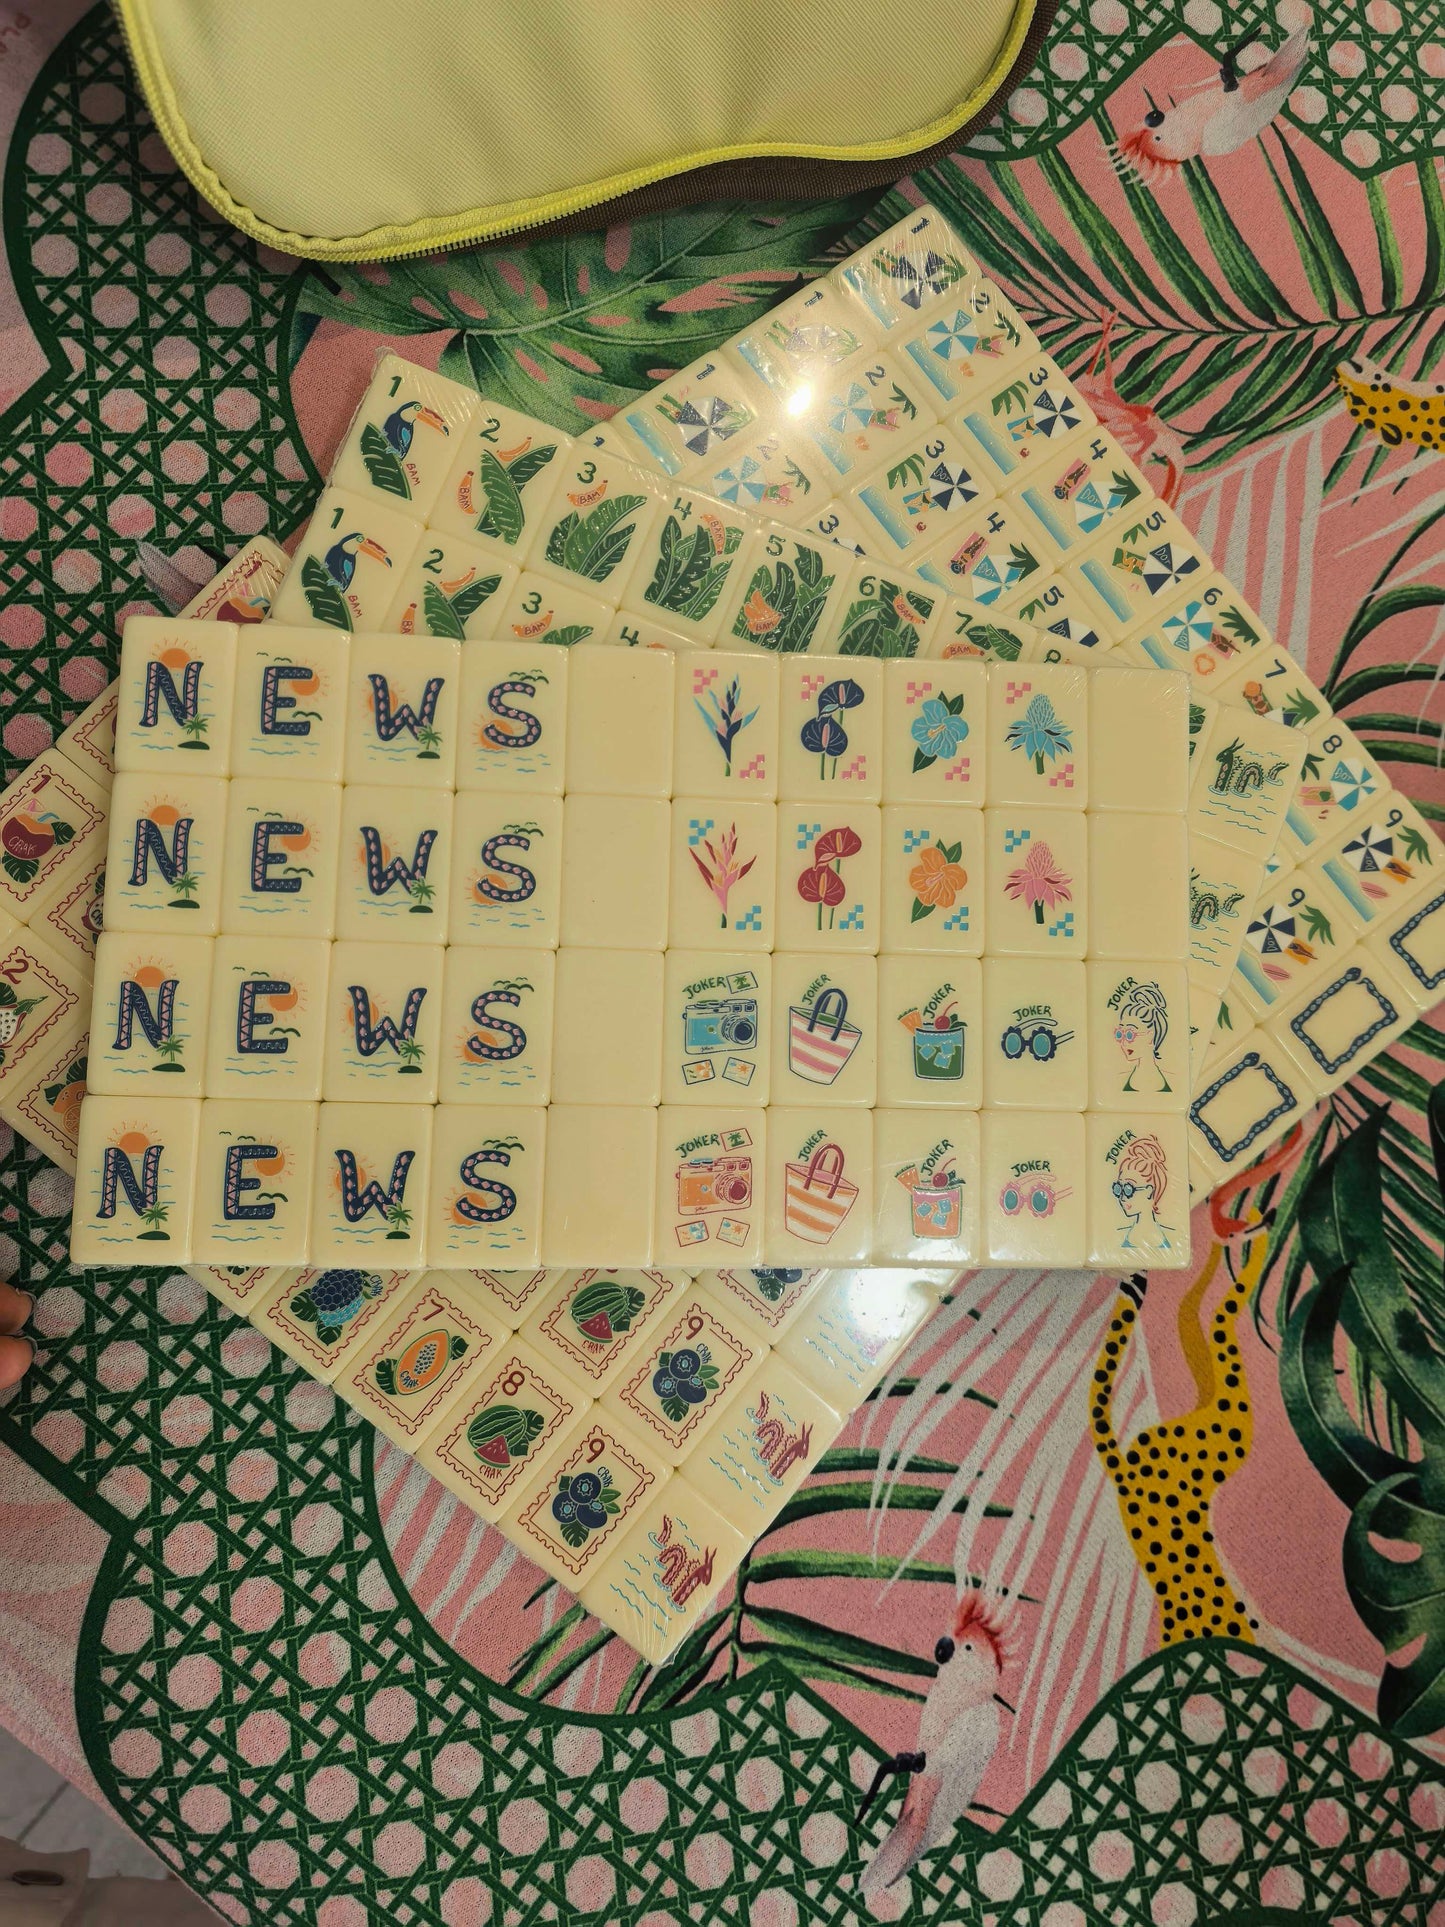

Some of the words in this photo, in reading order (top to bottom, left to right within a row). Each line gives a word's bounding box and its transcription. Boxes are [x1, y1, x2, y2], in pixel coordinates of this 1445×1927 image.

[910, 216, 930, 235] 1
[804, 290, 824, 308] 1
[969, 292, 990, 313] 2
[696, 363, 716, 381] 1
[865, 365, 886, 387] 2
[1029, 367, 1048, 387] 3
[387, 375, 403, 397] 1
[479, 418, 501, 443] 2
[925, 440, 945, 459] 3
[1090, 439, 1107, 460] 4
[406, 463, 421, 487] BAM
[577, 462, 597, 484] 3
[459, 487, 472, 510] BAM
[578, 489, 601, 505] BAM
[330, 507, 345, 530] 1
[673, 497, 692, 521] 4
[711, 520, 724, 543] BAM
[819, 514, 839, 534] 3
[987, 511, 1006, 533] 4
[1146, 511, 1166, 531] 5
[766, 535, 786, 557] 5
[423, 549, 444, 574] 2
[859, 576, 877, 597] 6
[1043, 585, 1064, 607] 5
[1204, 587, 1223, 606] 6
[348, 595, 362, 619] BAM
[522, 591, 543, 614] 3
[896, 602, 914, 622] BAM
[523, 620, 546, 635] BAM
[755, 619, 775, 633] BAM
[955, 610, 973, 635] 7
[620, 626, 640, 646] 4
[950, 645, 972, 655] BAM
[1265, 658, 1287, 679] 7
[138, 661, 204, 728] N
[261, 665, 314, 736] E
[367, 673, 446, 743] W
[484, 680, 543, 749] S
[1323, 734, 1343, 754] 8
[32, 774, 52, 794] 1
[1385, 808, 1403, 828] 9
[8, 835, 37, 856] CRAK
[128, 818, 194, 887] N
[251, 821, 305, 893] E
[360, 826, 439, 897] W
[476, 834, 537, 903] S
[1287, 888, 1305, 907] 9
[2, 958, 29, 985] 2
[682, 975, 727, 1000] JOKER
[801, 973, 831, 1006] JOKER
[1106, 976, 1138, 1011] JOKER
[922, 983, 956, 1019] JOKER
[112, 979, 180, 1051] N
[237, 980, 292, 1054] E
[347, 985, 428, 1058] W
[466, 989, 528, 1061] S
[1012, 1005, 1052, 1021] JOKER
[675, 1133, 720, 1159] JOKER
[797, 1128, 828, 1162] JOKER
[1105, 1129, 1137, 1165] JOKER
[920, 1138, 954, 1177] JOKER
[1010, 1159, 1051, 1178] JOKER
[96, 1145, 164, 1220] N
[223, 1145, 279, 1221] E
[334, 1149, 417, 1223] W
[456, 1149, 518, 1223] S
[422, 1302, 445, 1322] 7
[685, 1315, 704, 1340] 9
[581, 1340, 605, 1355] CRAK
[502, 1370, 526, 1396] 8
[586, 1438, 605, 1463] 9
[478, 1464, 503, 1479] CRAK
